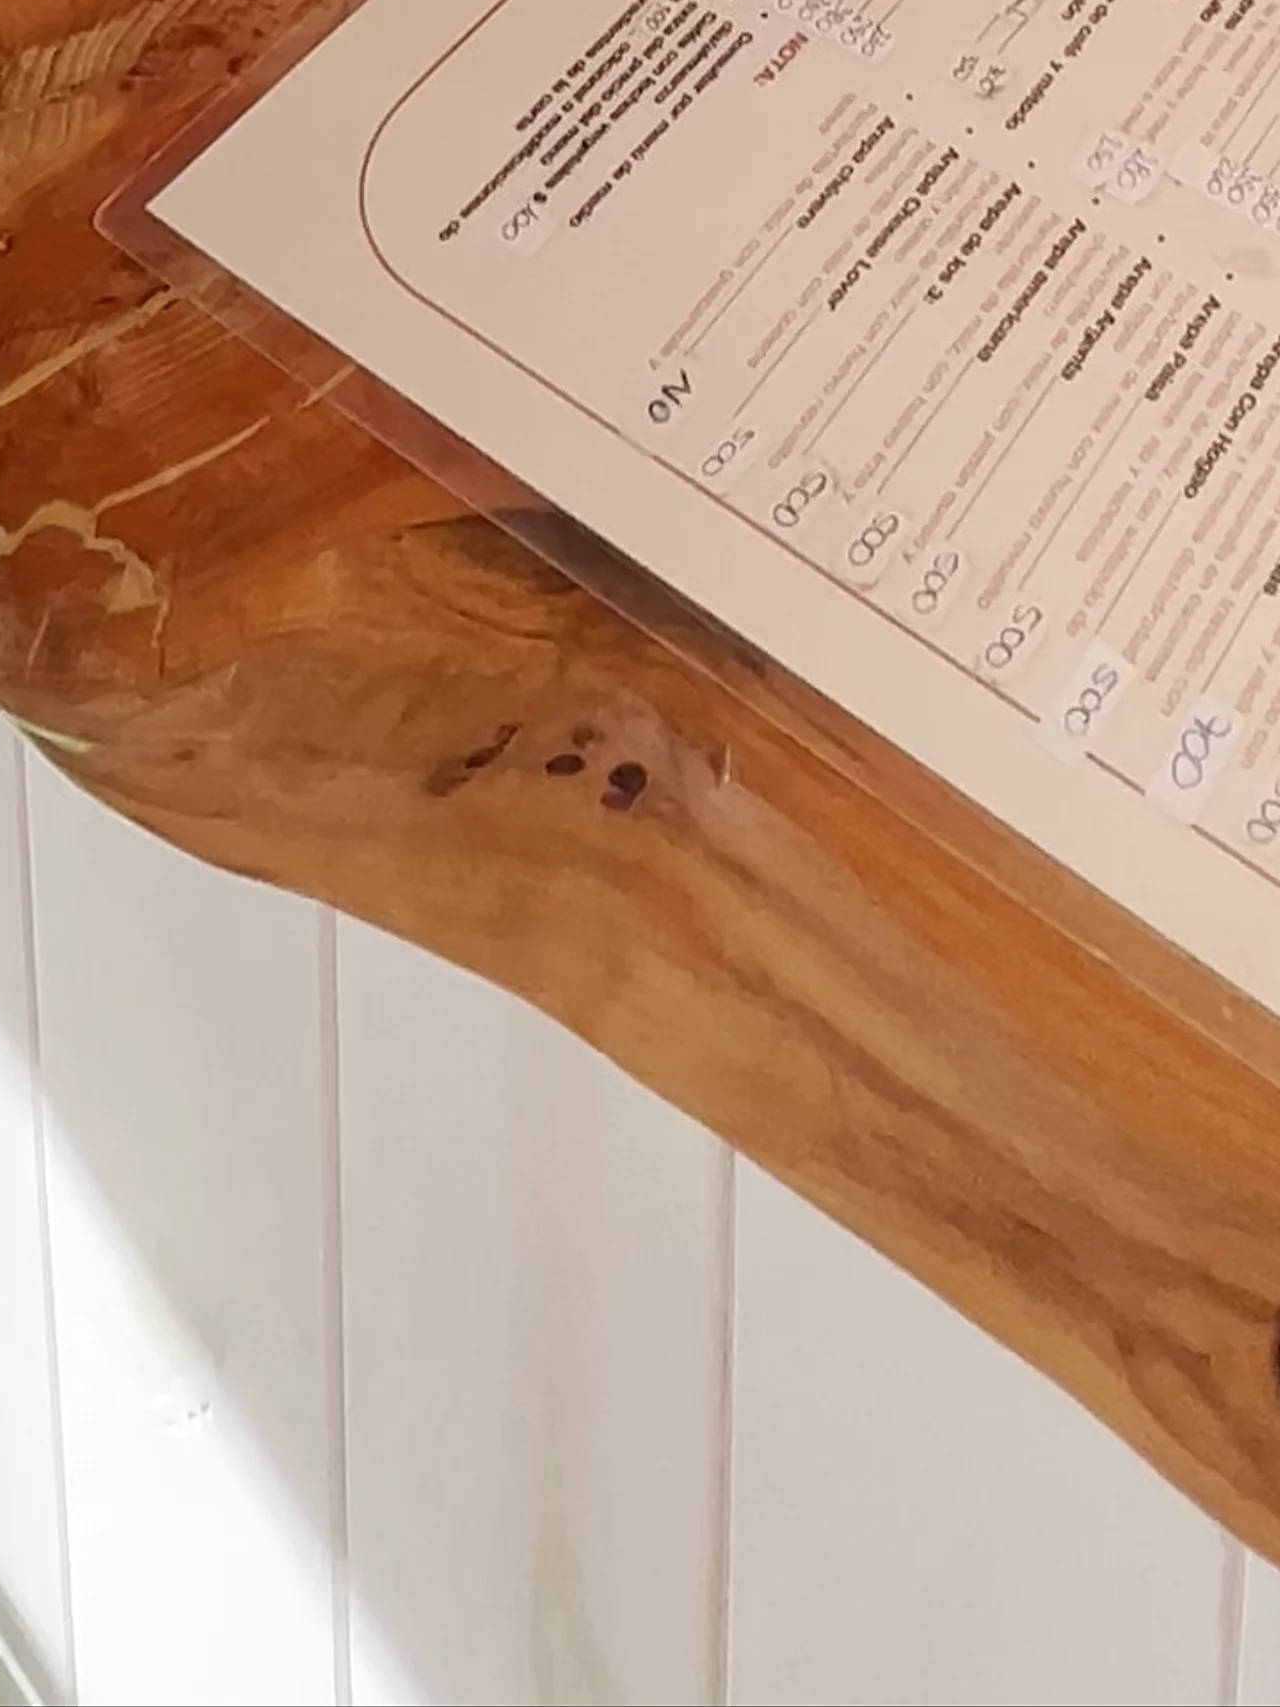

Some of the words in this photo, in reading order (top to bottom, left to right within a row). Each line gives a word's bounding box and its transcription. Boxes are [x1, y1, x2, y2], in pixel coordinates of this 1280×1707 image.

[1086, 2, 1109, 26] de
[751, 29, 810, 87] NOTA:
[667, 90, 694, 122] por
[850, 113, 896, 165] Arepa
[610, 158, 633, 182] de
[914, 144, 960, 197] Arepa
[567, 179, 614, 229] medio
[864, 195, 922, 259] Cheese
[977, 180, 1023, 233] Arepa
[936, 254, 968, 285] los
[958, 230, 983, 257] de
[1041, 215, 1088, 271] Arepa
[825, 257, 873, 313] Lover
[921, 282, 945, 306] 3:
[1109, 254, 1153, 311] Arepa
[974, 268, 1049, 363] americana
[1177, 292, 1222, 351] Arepa
[1058, 307, 1117, 382] Argenta
[646, 366, 693, 425] NO
[1142, 349, 1188, 403] Paisa
[1222, 390, 1258, 433] Con
[699, 425, 756, 478] 500
[1182, 430, 1234, 500] Hogao
[771, 469, 828, 529] 500
[846, 510, 900, 568] 500
[910, 550, 960, 615] 500
[983, 603, 1044, 670] 500
[1063, 662, 1119, 738] 500
[1170, 715, 1232, 790] 700
